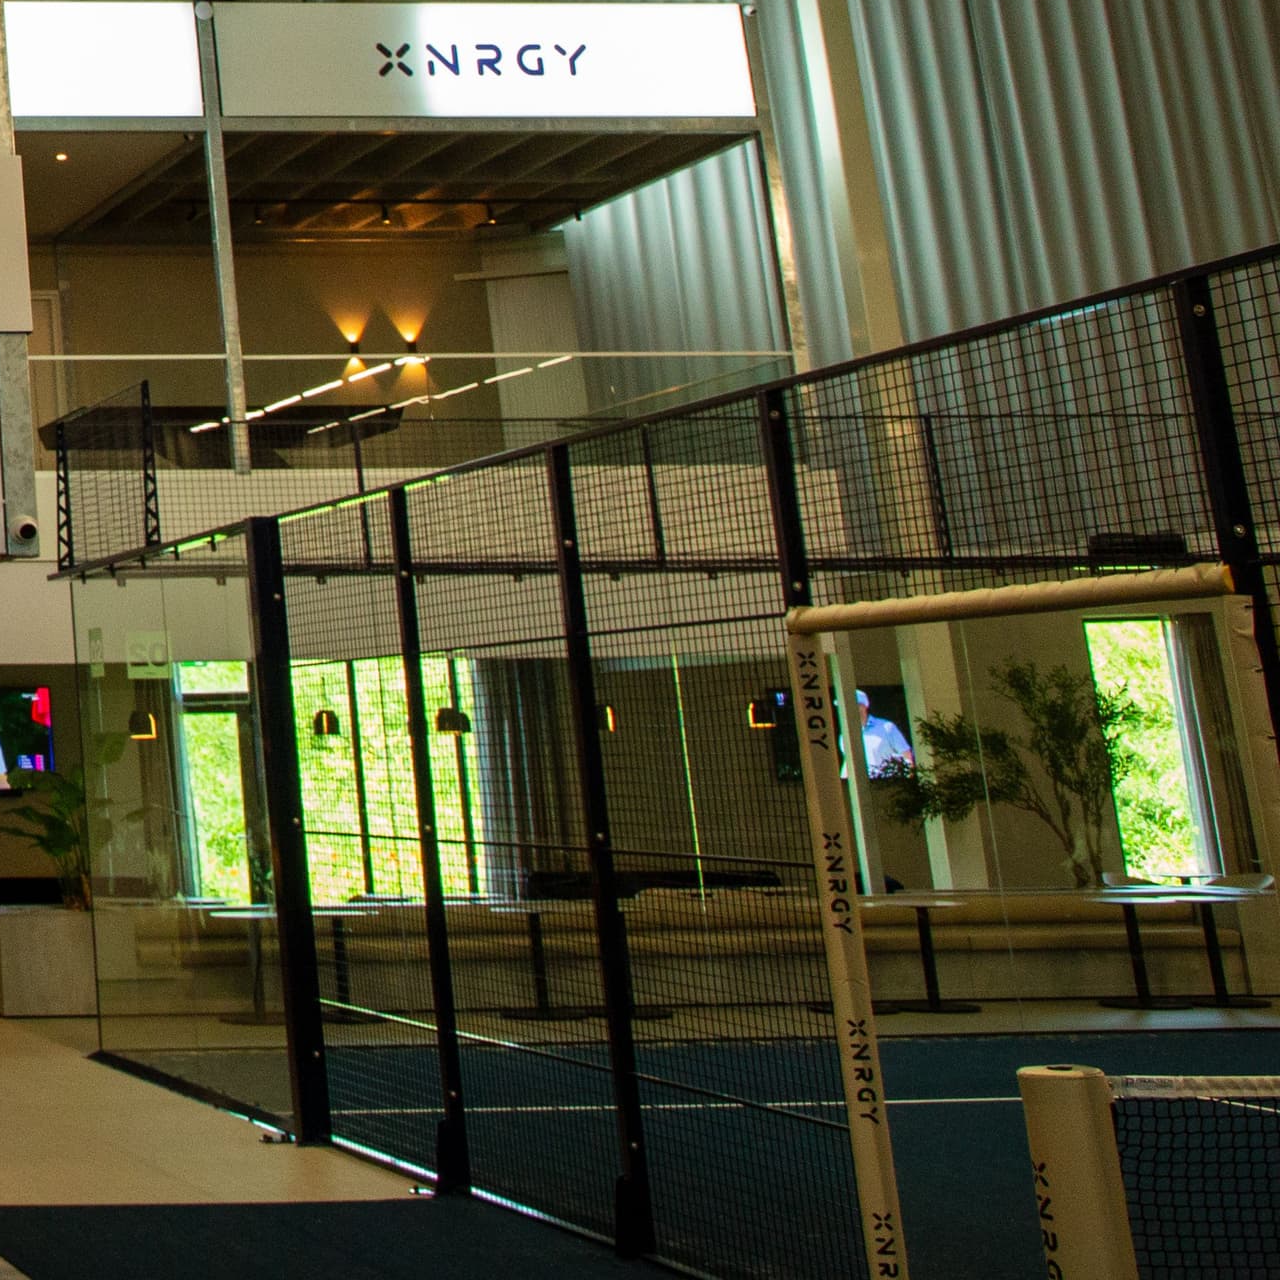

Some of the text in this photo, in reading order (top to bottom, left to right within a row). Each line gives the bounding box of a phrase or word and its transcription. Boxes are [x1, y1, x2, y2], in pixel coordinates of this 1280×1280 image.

[376, 41, 588, 78] XNRGY
[796, 651, 829, 751] XNRGY
[822, 831, 853, 935] XNRGY
[846, 1019, 881, 1125] XNRGY
